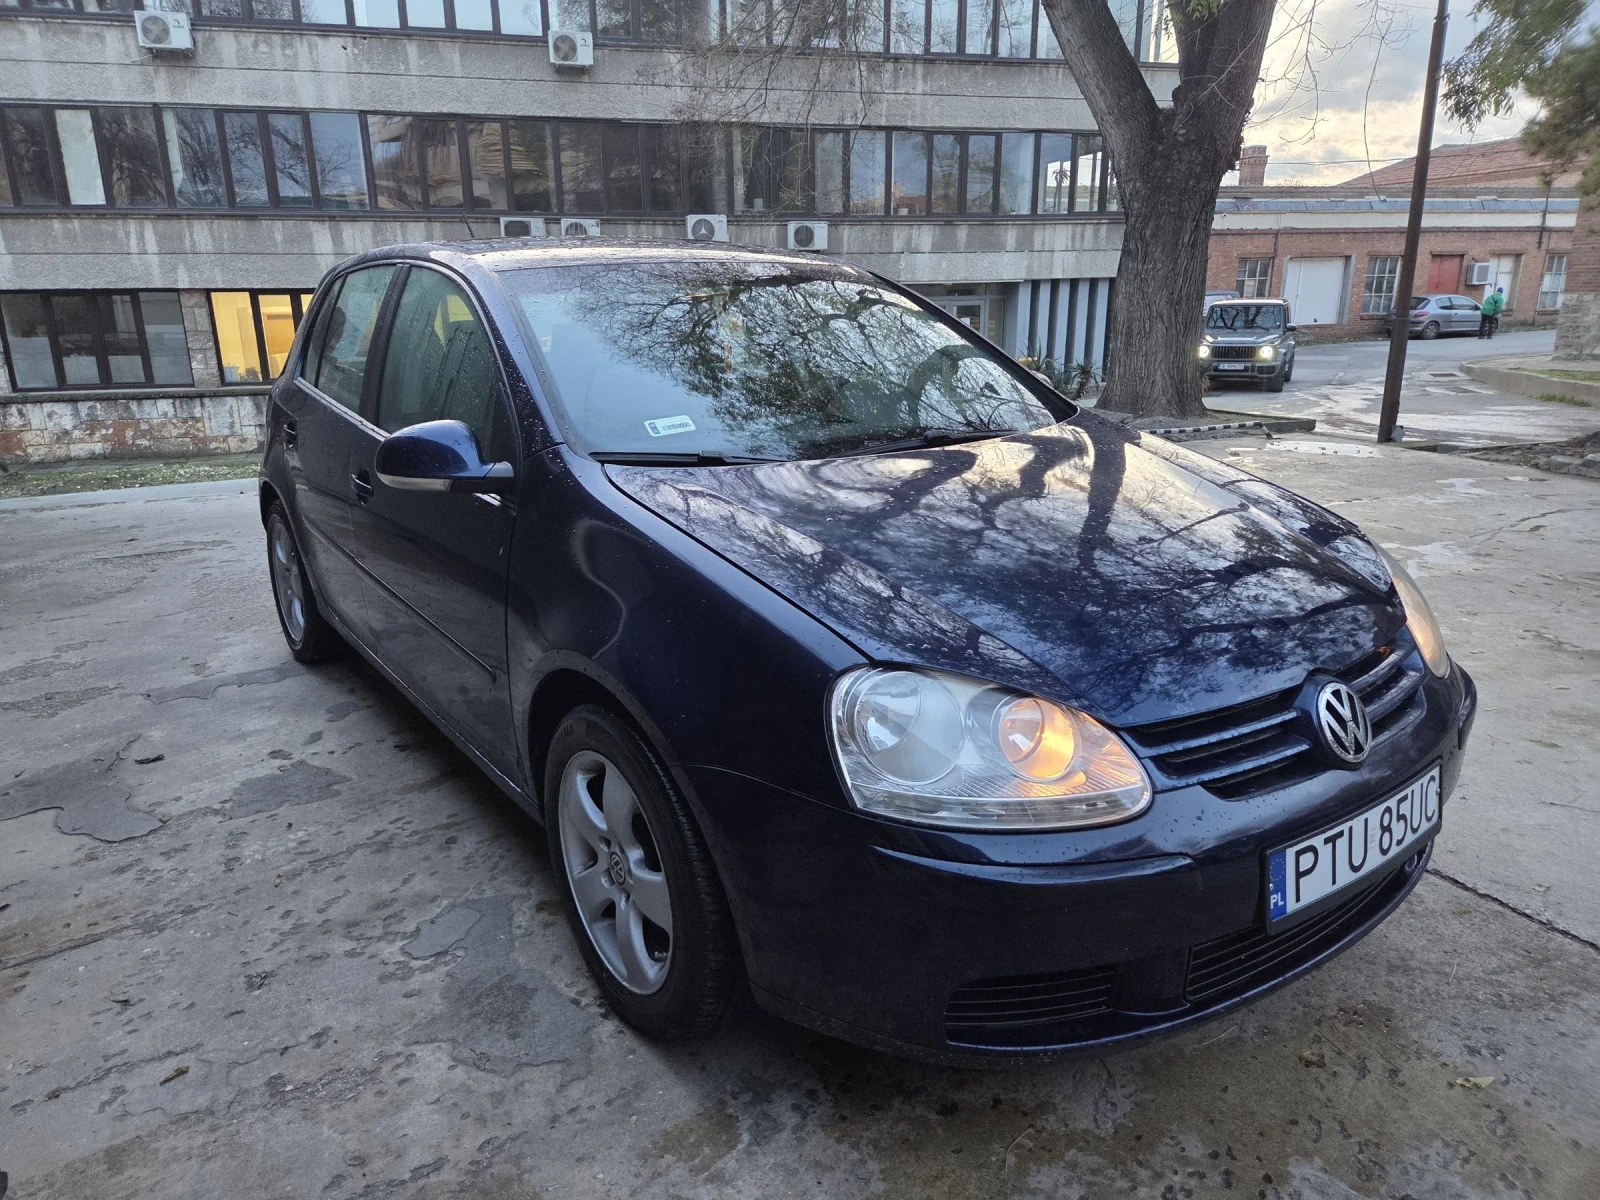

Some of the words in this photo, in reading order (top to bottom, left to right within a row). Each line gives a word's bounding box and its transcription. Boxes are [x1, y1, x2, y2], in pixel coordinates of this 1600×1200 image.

[1319, 683, 1371, 762] VW
[1294, 817, 1369, 904] PTU
[1378, 774, 1437, 857] 85UC
[1270, 891, 1285, 909] PL
